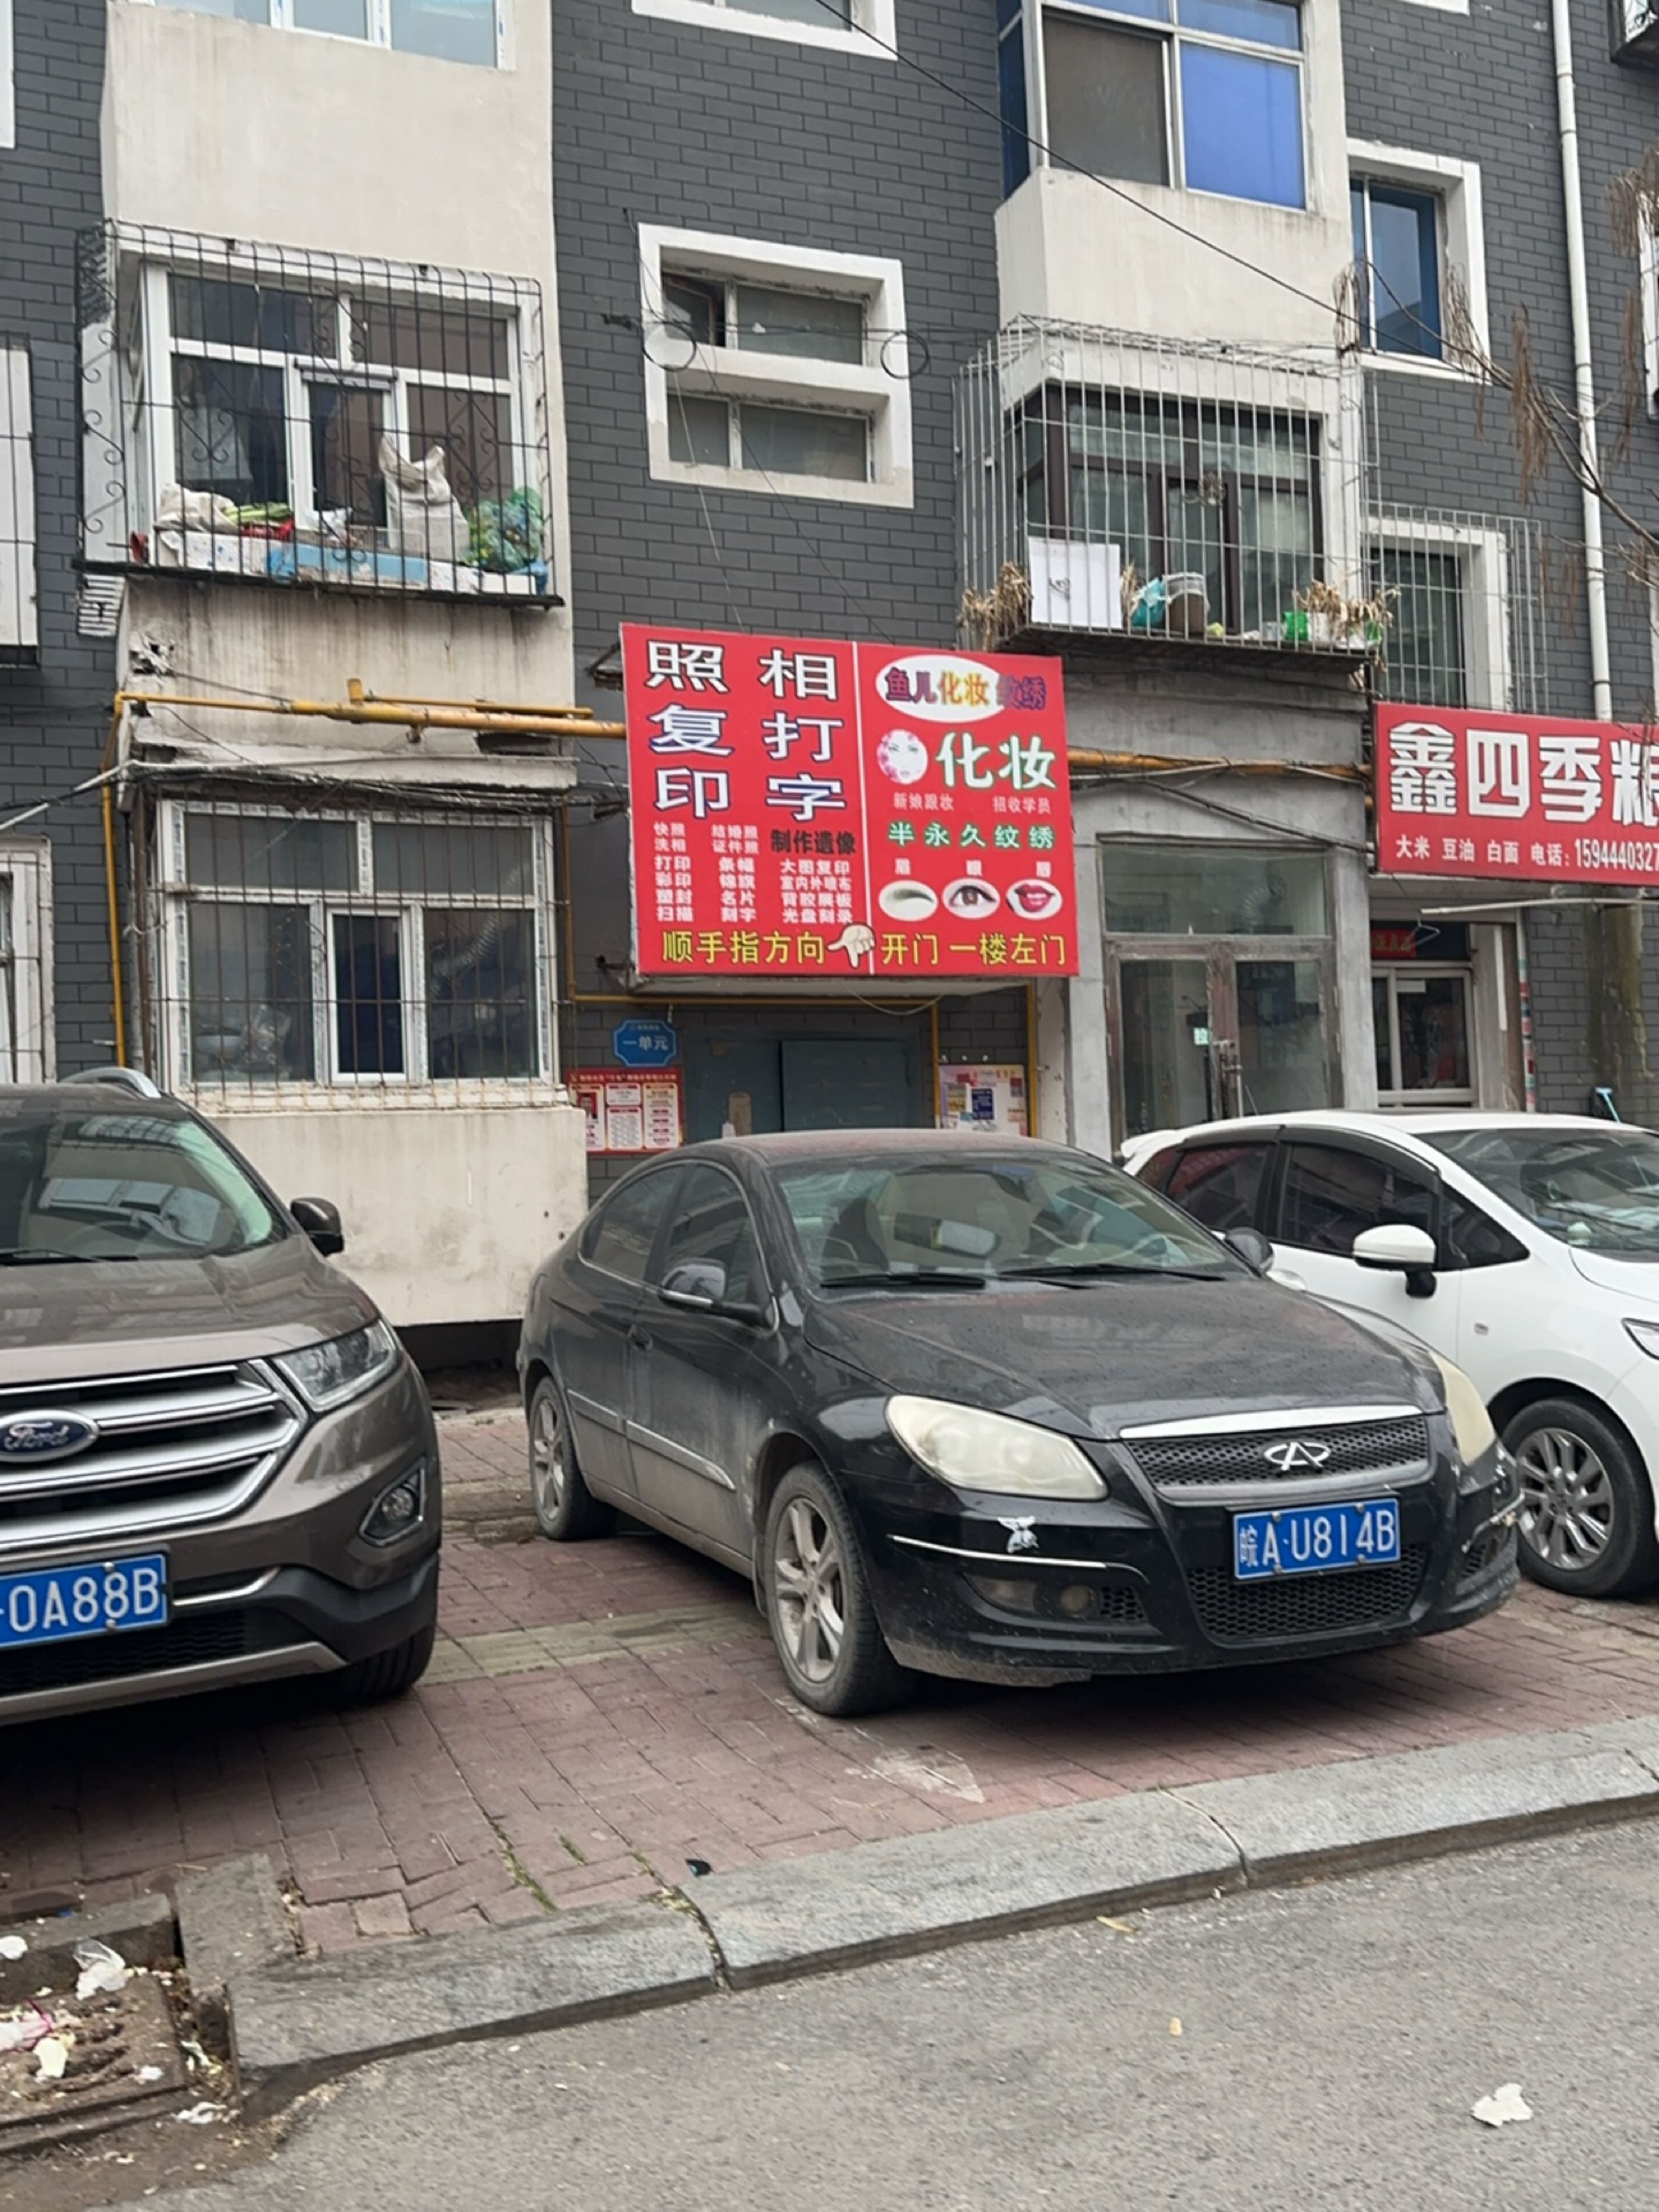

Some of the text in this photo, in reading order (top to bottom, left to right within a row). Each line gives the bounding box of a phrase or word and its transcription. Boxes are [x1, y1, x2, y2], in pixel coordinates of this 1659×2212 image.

[934, 732, 1057, 790] 化妆
[992, 796, 1052, 814] 招收学员
[887, 821, 1055, 849] 半永久纹绣
[1395, 833, 1431, 861] 大米
[1441, 838, 1475, 863] 豆油
[1487, 839, 1520, 866] 白面
[655, 854, 691, 871] 打印
[721, 890, 755, 906] 名片
[657, 905, 693, 922] 扫描
[663, 930, 824, 964] 顺手指方向
[623, 1036, 669, 1051] 一单元
[4, 1421, 69, 1450] Ford
